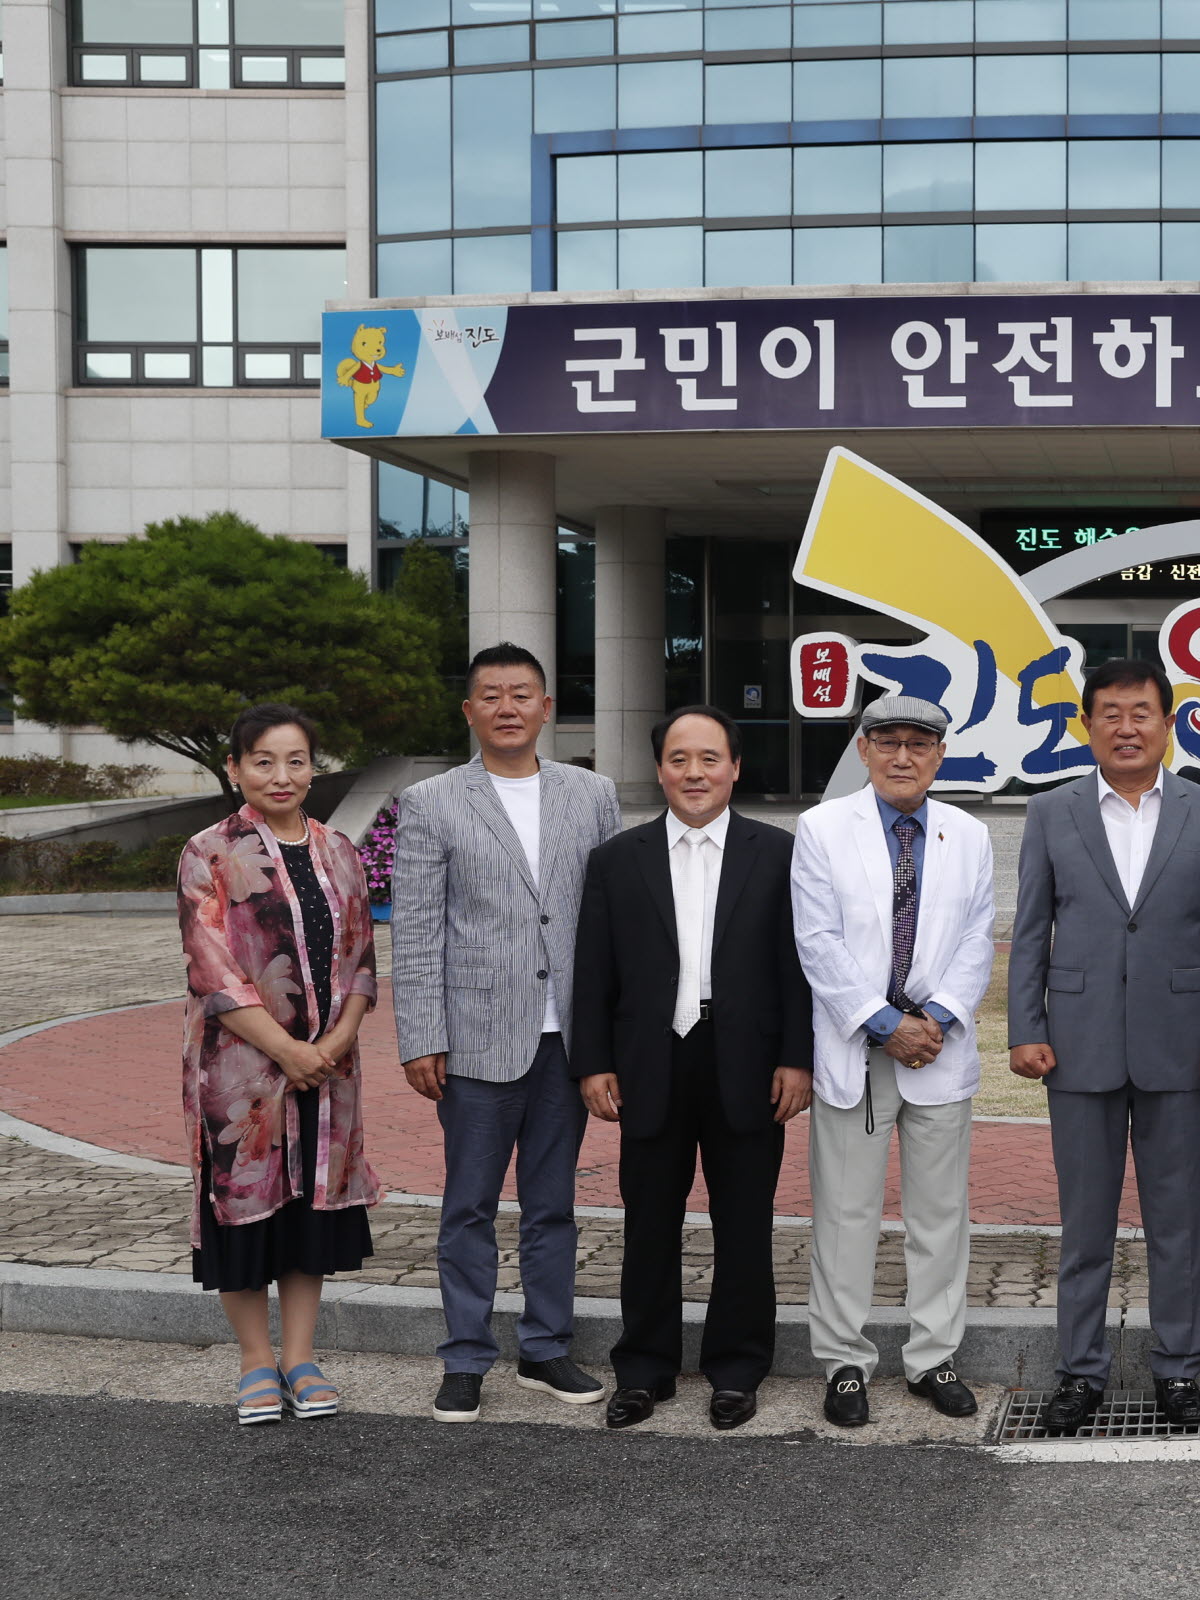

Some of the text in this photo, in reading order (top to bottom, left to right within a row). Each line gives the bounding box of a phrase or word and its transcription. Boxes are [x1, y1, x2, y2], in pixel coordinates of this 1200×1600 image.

[434, 326, 500, 349] 보배섬 진도
[566, 320, 835, 412] 군민이
[1016, 527, 1062, 551] 진도
[812, 648, 833, 702] 보배섬
